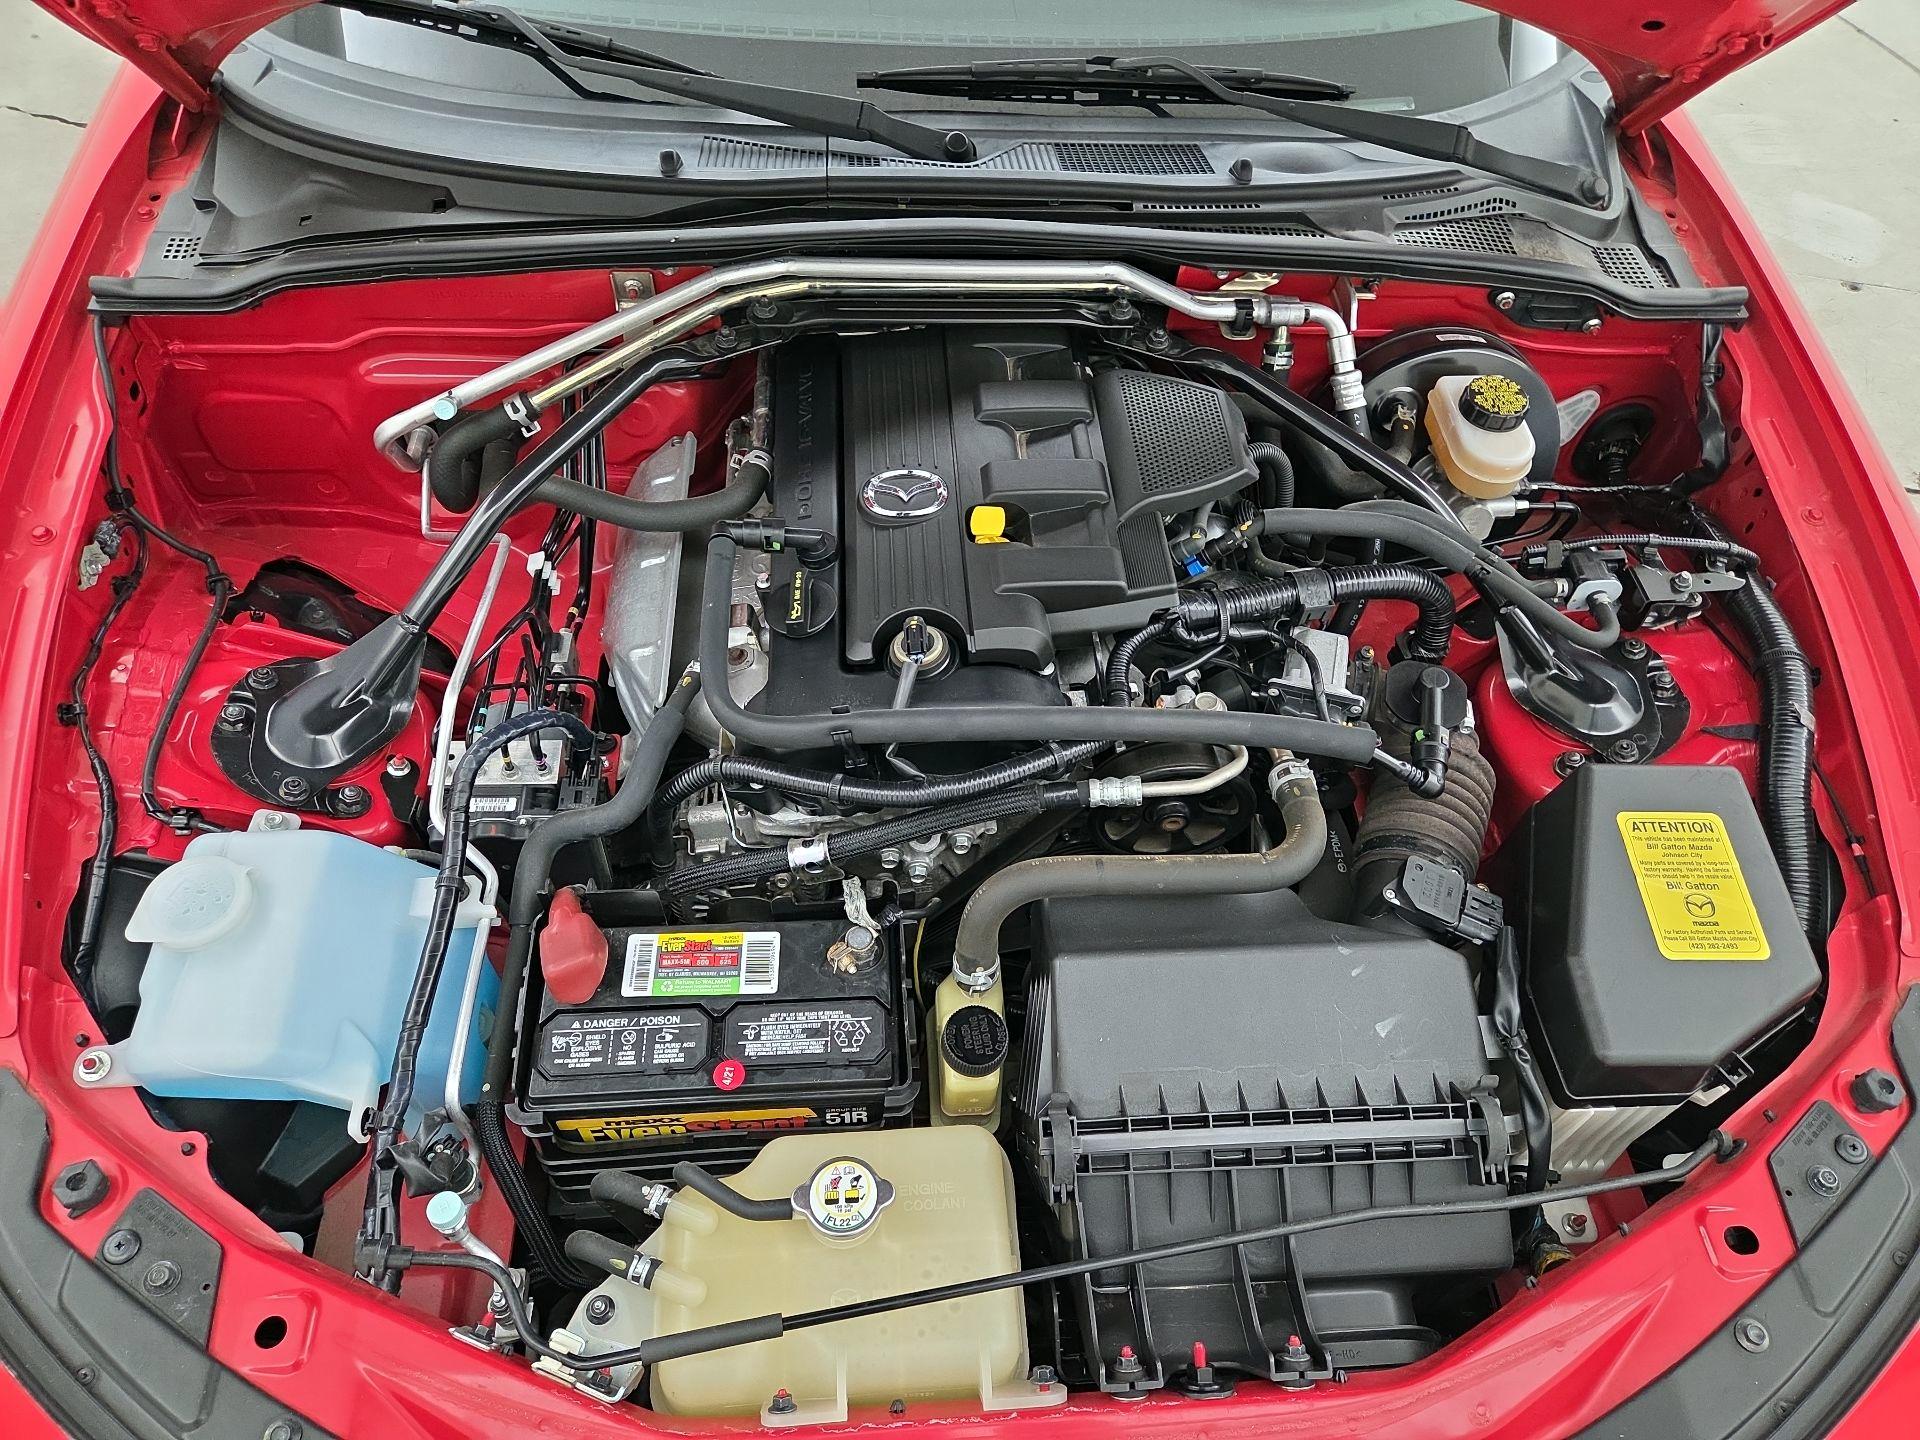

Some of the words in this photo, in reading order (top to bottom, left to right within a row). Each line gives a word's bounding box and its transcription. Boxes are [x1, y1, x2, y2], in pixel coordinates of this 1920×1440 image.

[1632, 821, 1714, 833] ATTENTION
[1666, 881, 1683, 890] Bill
[1686, 882, 1720, 890] Gatton
[662, 940, 712, 952] EverStart
[584, 1018, 628, 1028] DANGER
[630, 1018, 638, 1026] /
[640, 1016, 680, 1026] POISON
[978, 1014, 989, 1032] ONLY
[960, 1024, 974, 1050] POWER
[968, 1016, 984, 1055] STEERING
[994, 1026, 1006, 1050] CLOSE
[654, 1042, 682, 1050] SULFURIC
[982, 1033, 994, 1055] FLUID
[722, 1066, 734, 1086] 4/21
[604, 1117, 686, 1126] maxx
[826, 1112, 868, 1124] 51R
[900, 1182, 954, 1195] ENGINE
[903, 1199, 967, 1212] COOLANT
[826, 1216, 852, 1227] FL22
